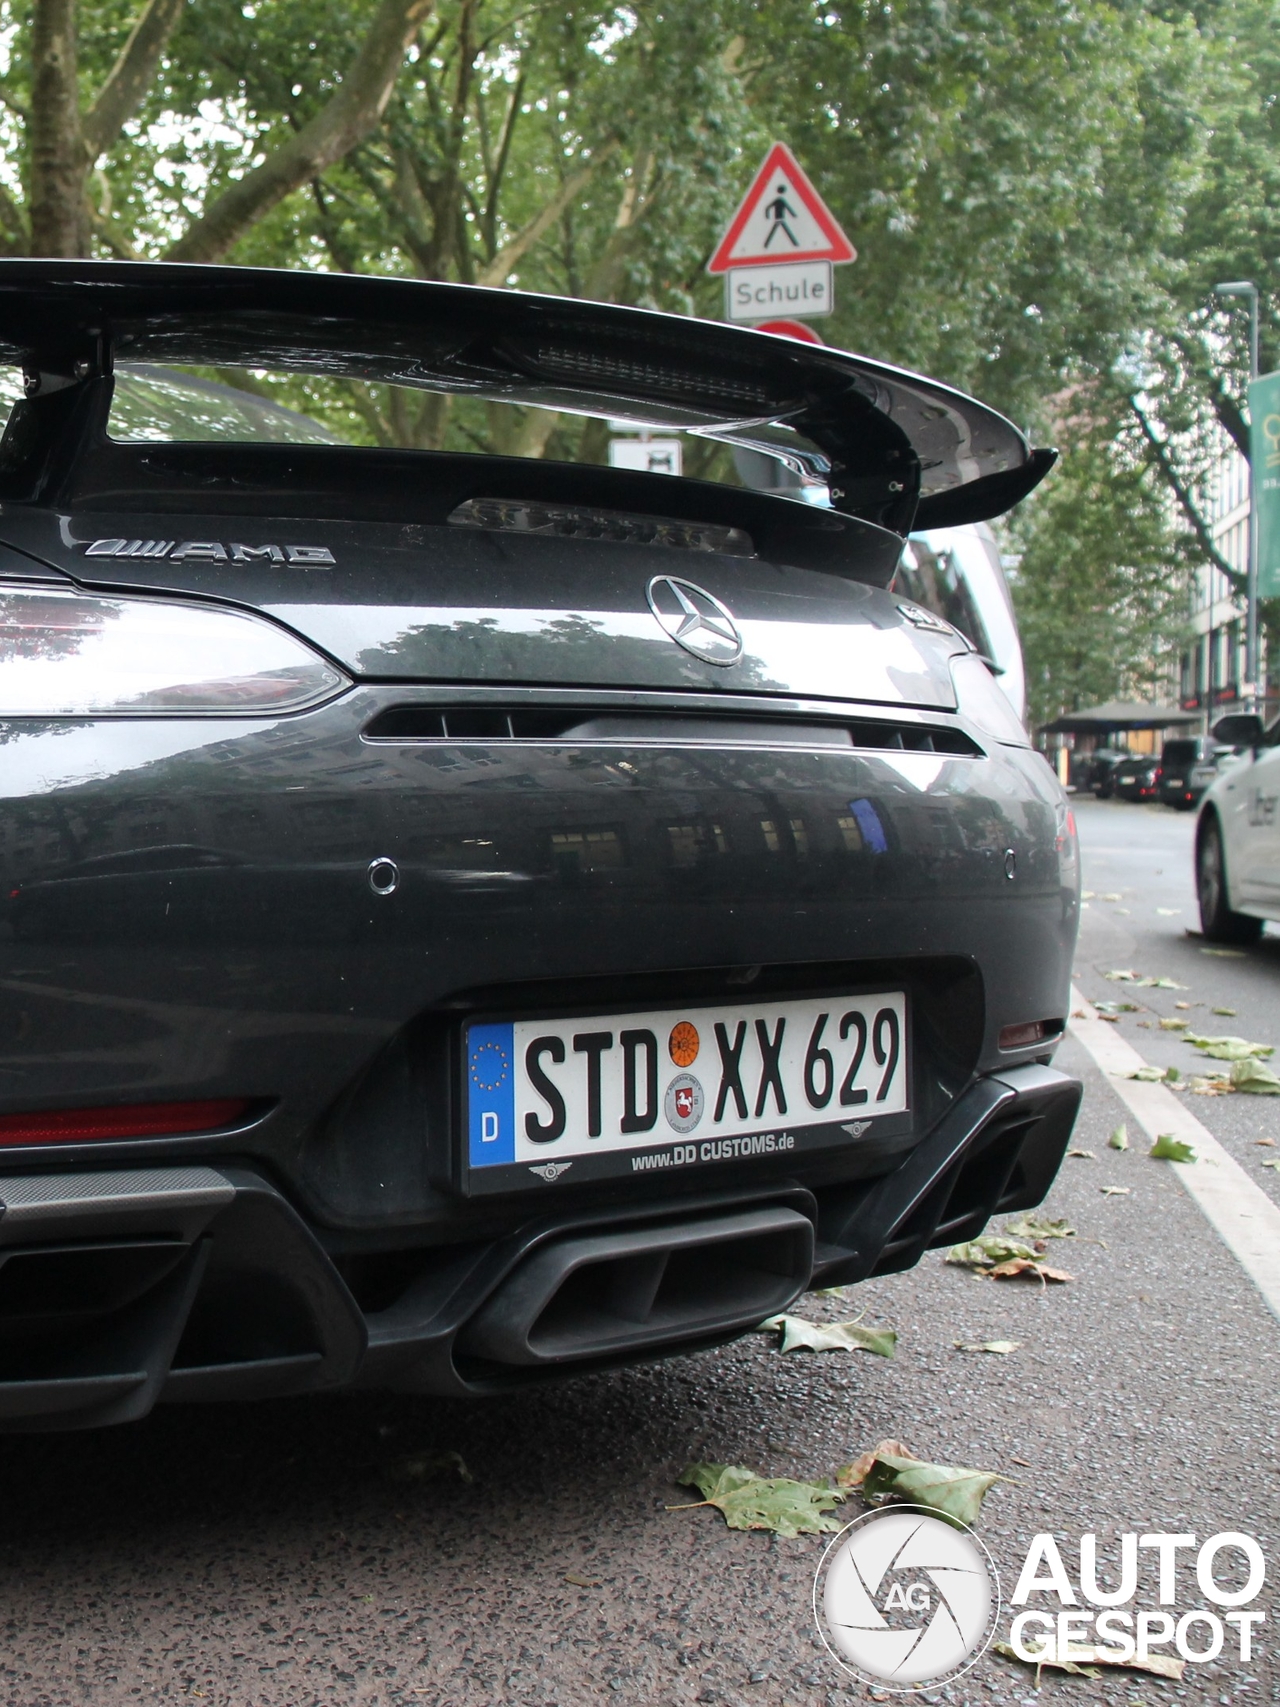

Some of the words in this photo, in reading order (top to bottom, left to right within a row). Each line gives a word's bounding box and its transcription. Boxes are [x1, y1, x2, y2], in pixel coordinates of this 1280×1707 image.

[736, 278, 825, 306] Schule
[170, 541, 336, 564] AMG
[525, 1028, 658, 1143] STD
[714, 1017, 788, 1123] XX
[804, 1007, 900, 1110] 629
[482, 1111, 499, 1143] D
[631, 1145, 697, 1171] www.DD
[700, 1132, 795, 1161] CUSTOMS.de
